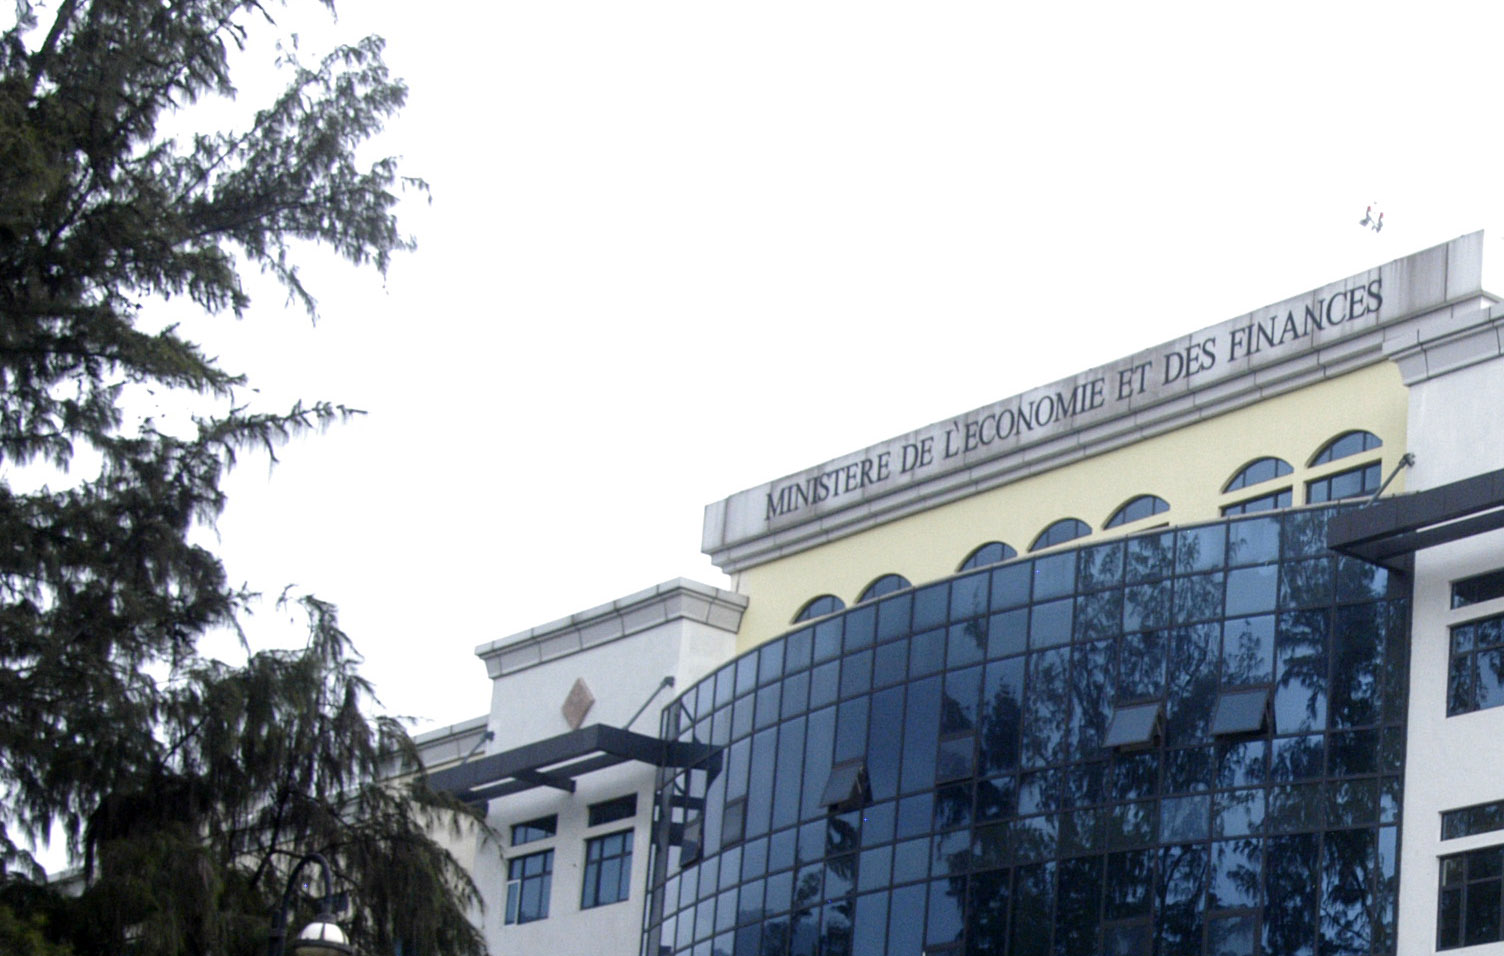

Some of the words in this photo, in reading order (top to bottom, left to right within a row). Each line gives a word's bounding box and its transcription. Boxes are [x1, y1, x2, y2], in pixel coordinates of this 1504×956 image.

[764, 451, 891, 521] MINISTERE
[900, 436, 935, 474] DE
[1116, 360, 1153, 402] ET
[1162, 336, 1217, 386] DES
[1227, 277, 1384, 363] FINANCES
